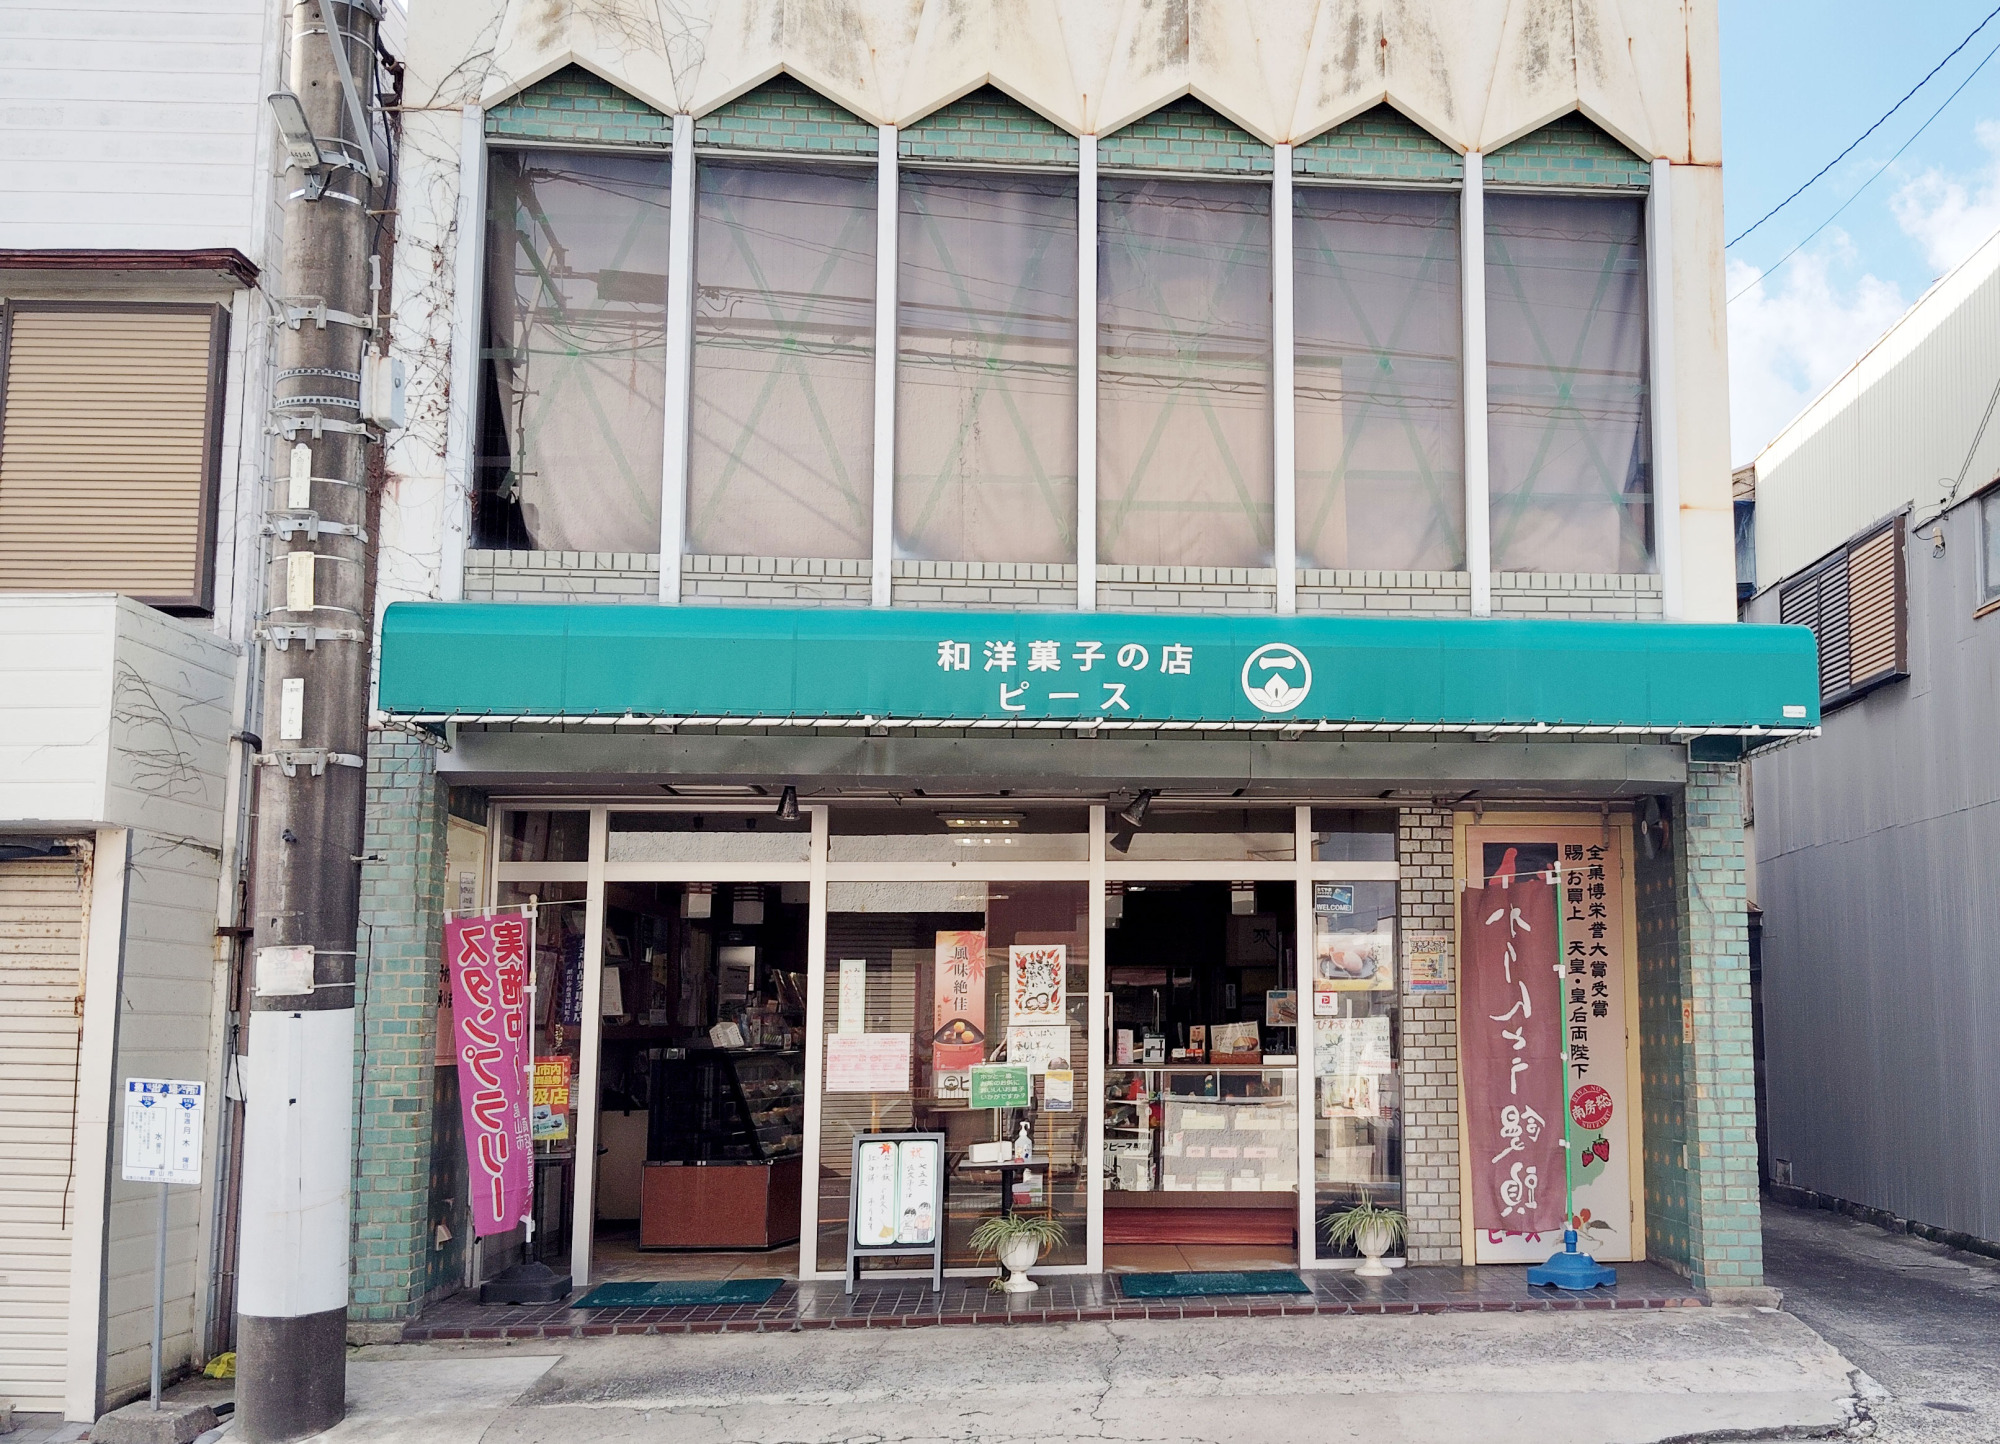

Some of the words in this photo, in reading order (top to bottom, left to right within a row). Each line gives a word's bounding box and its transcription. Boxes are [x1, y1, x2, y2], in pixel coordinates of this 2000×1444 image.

[937, 640, 1194, 675] 和洋菓子の店
[999, 681, 1131, 711] ピース
[1316, 903, 1352, 911] WELCOME!
[1566, 870, 1585, 921] お買上
[1586, 844, 1609, 1018] 全菓博栄誉大賞受賞
[953, 946, 969, 1012] 風味絶佳
[1566, 940, 1590, 1080] 天皇・皇后両陛下
[918, 1164, 928, 1187] 七五三
